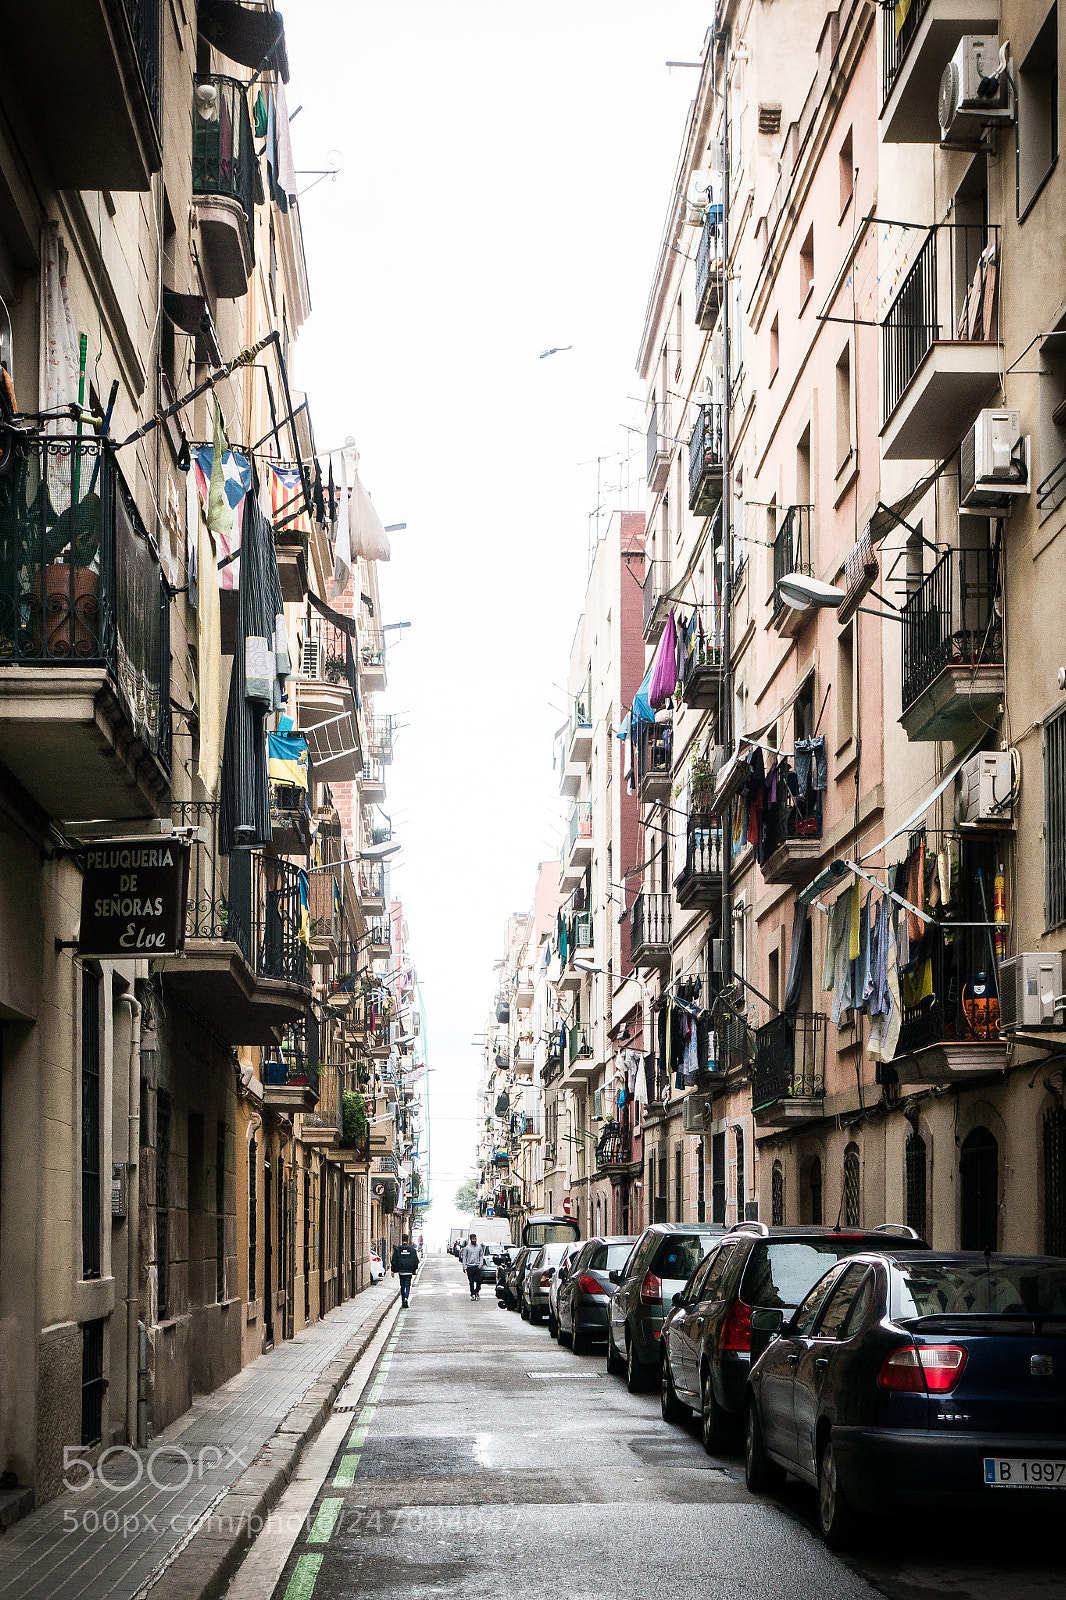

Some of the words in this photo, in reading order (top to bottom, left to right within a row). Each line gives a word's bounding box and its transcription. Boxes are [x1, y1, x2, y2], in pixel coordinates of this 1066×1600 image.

[87, 848, 174, 869] PELUQUERIA
[120, 874, 138, 892] DE
[94, 893, 163, 917] SEÑORAS
[119, 922, 166, 948] Elve
[999, 1462, 1012, 1481] B
[1021, 1462, 1066, 1482] 1997
